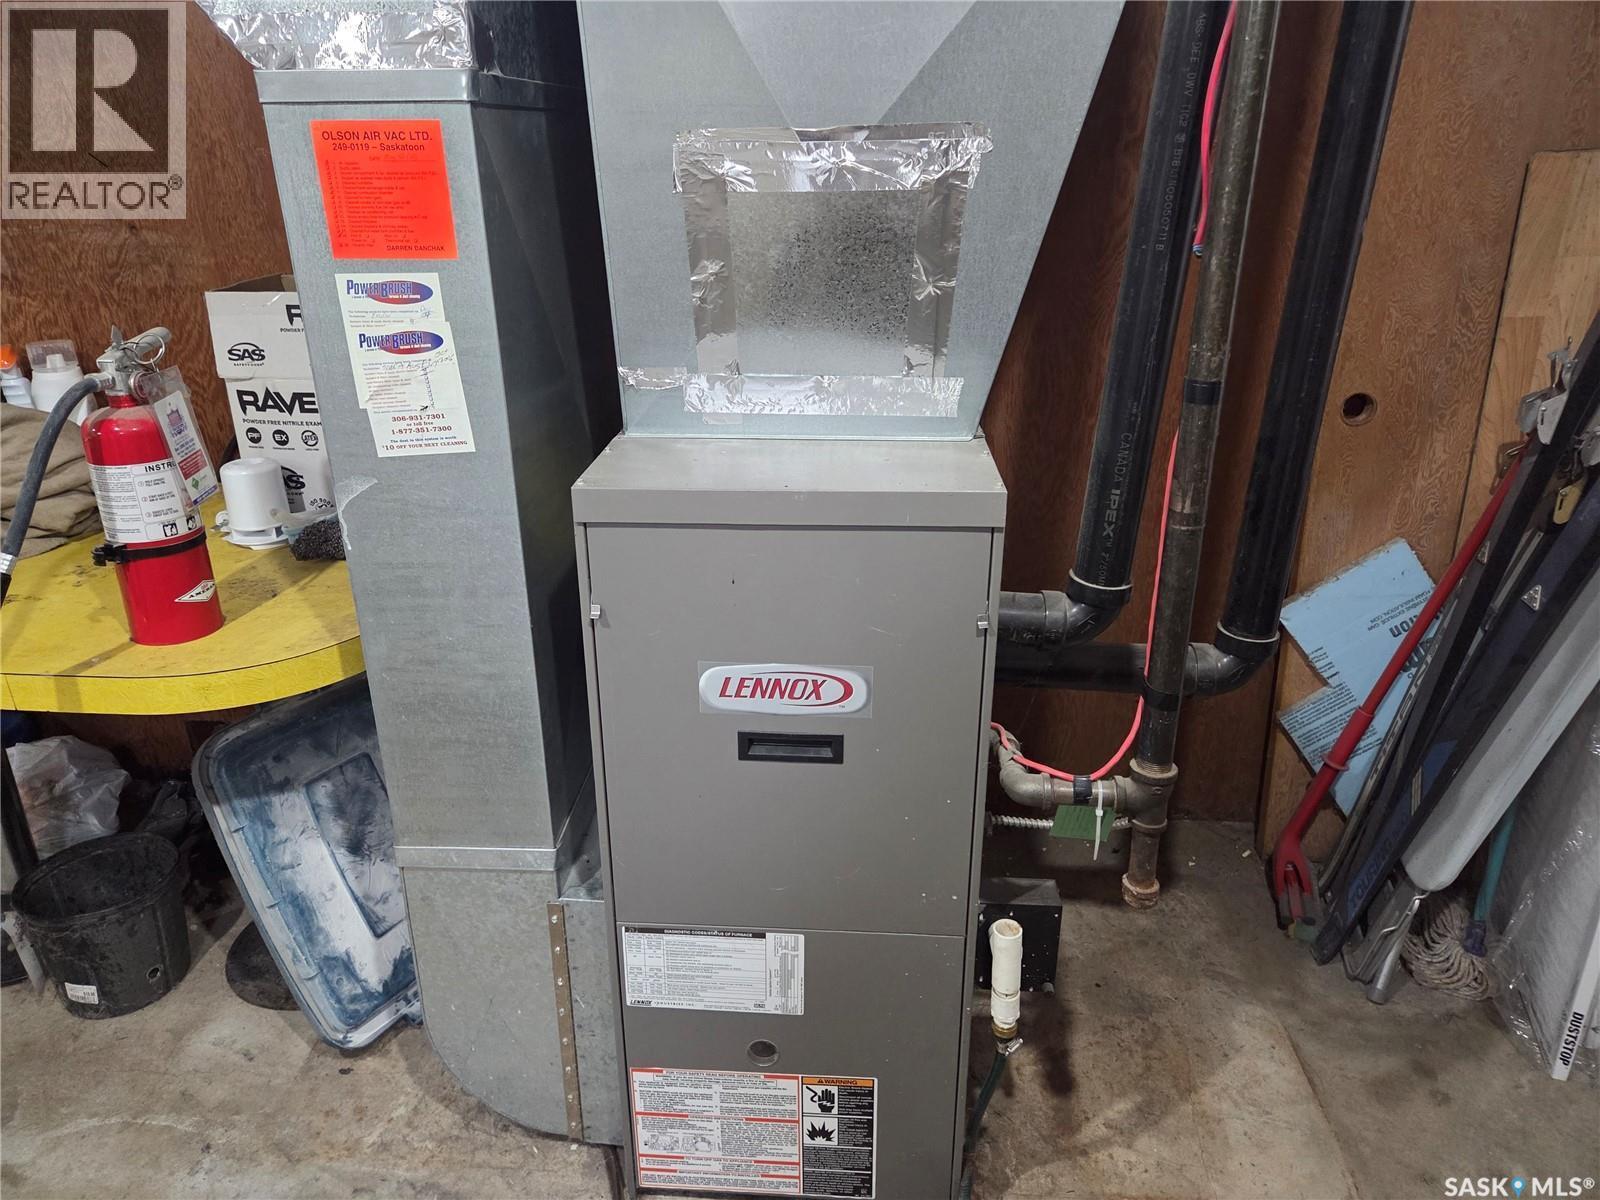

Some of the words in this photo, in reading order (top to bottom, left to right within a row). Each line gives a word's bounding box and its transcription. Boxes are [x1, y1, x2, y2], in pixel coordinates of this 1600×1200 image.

[322, 131, 360, 141] OLSON
[363, 131, 381, 141] AIR
[385, 131, 406, 141] VAC
[410, 131, 433, 141] LTD.
[332, 143, 370, 151] 249-0119
[380, 143, 425, 151] Saskatoon
[228, 349, 266, 362] SAS
[392, 413, 447, 423] 306-931-7301
[392, 426, 453, 436] 1-877-351-7300
[274, 434, 288, 442] EX
[1113, 432, 1133, 483] CANADA
[1102, 489, 1121, 537] IPEX
[719, 677, 828, 701] LENNOX
[1560, 1012, 1585, 1067] DUSTSTOP
